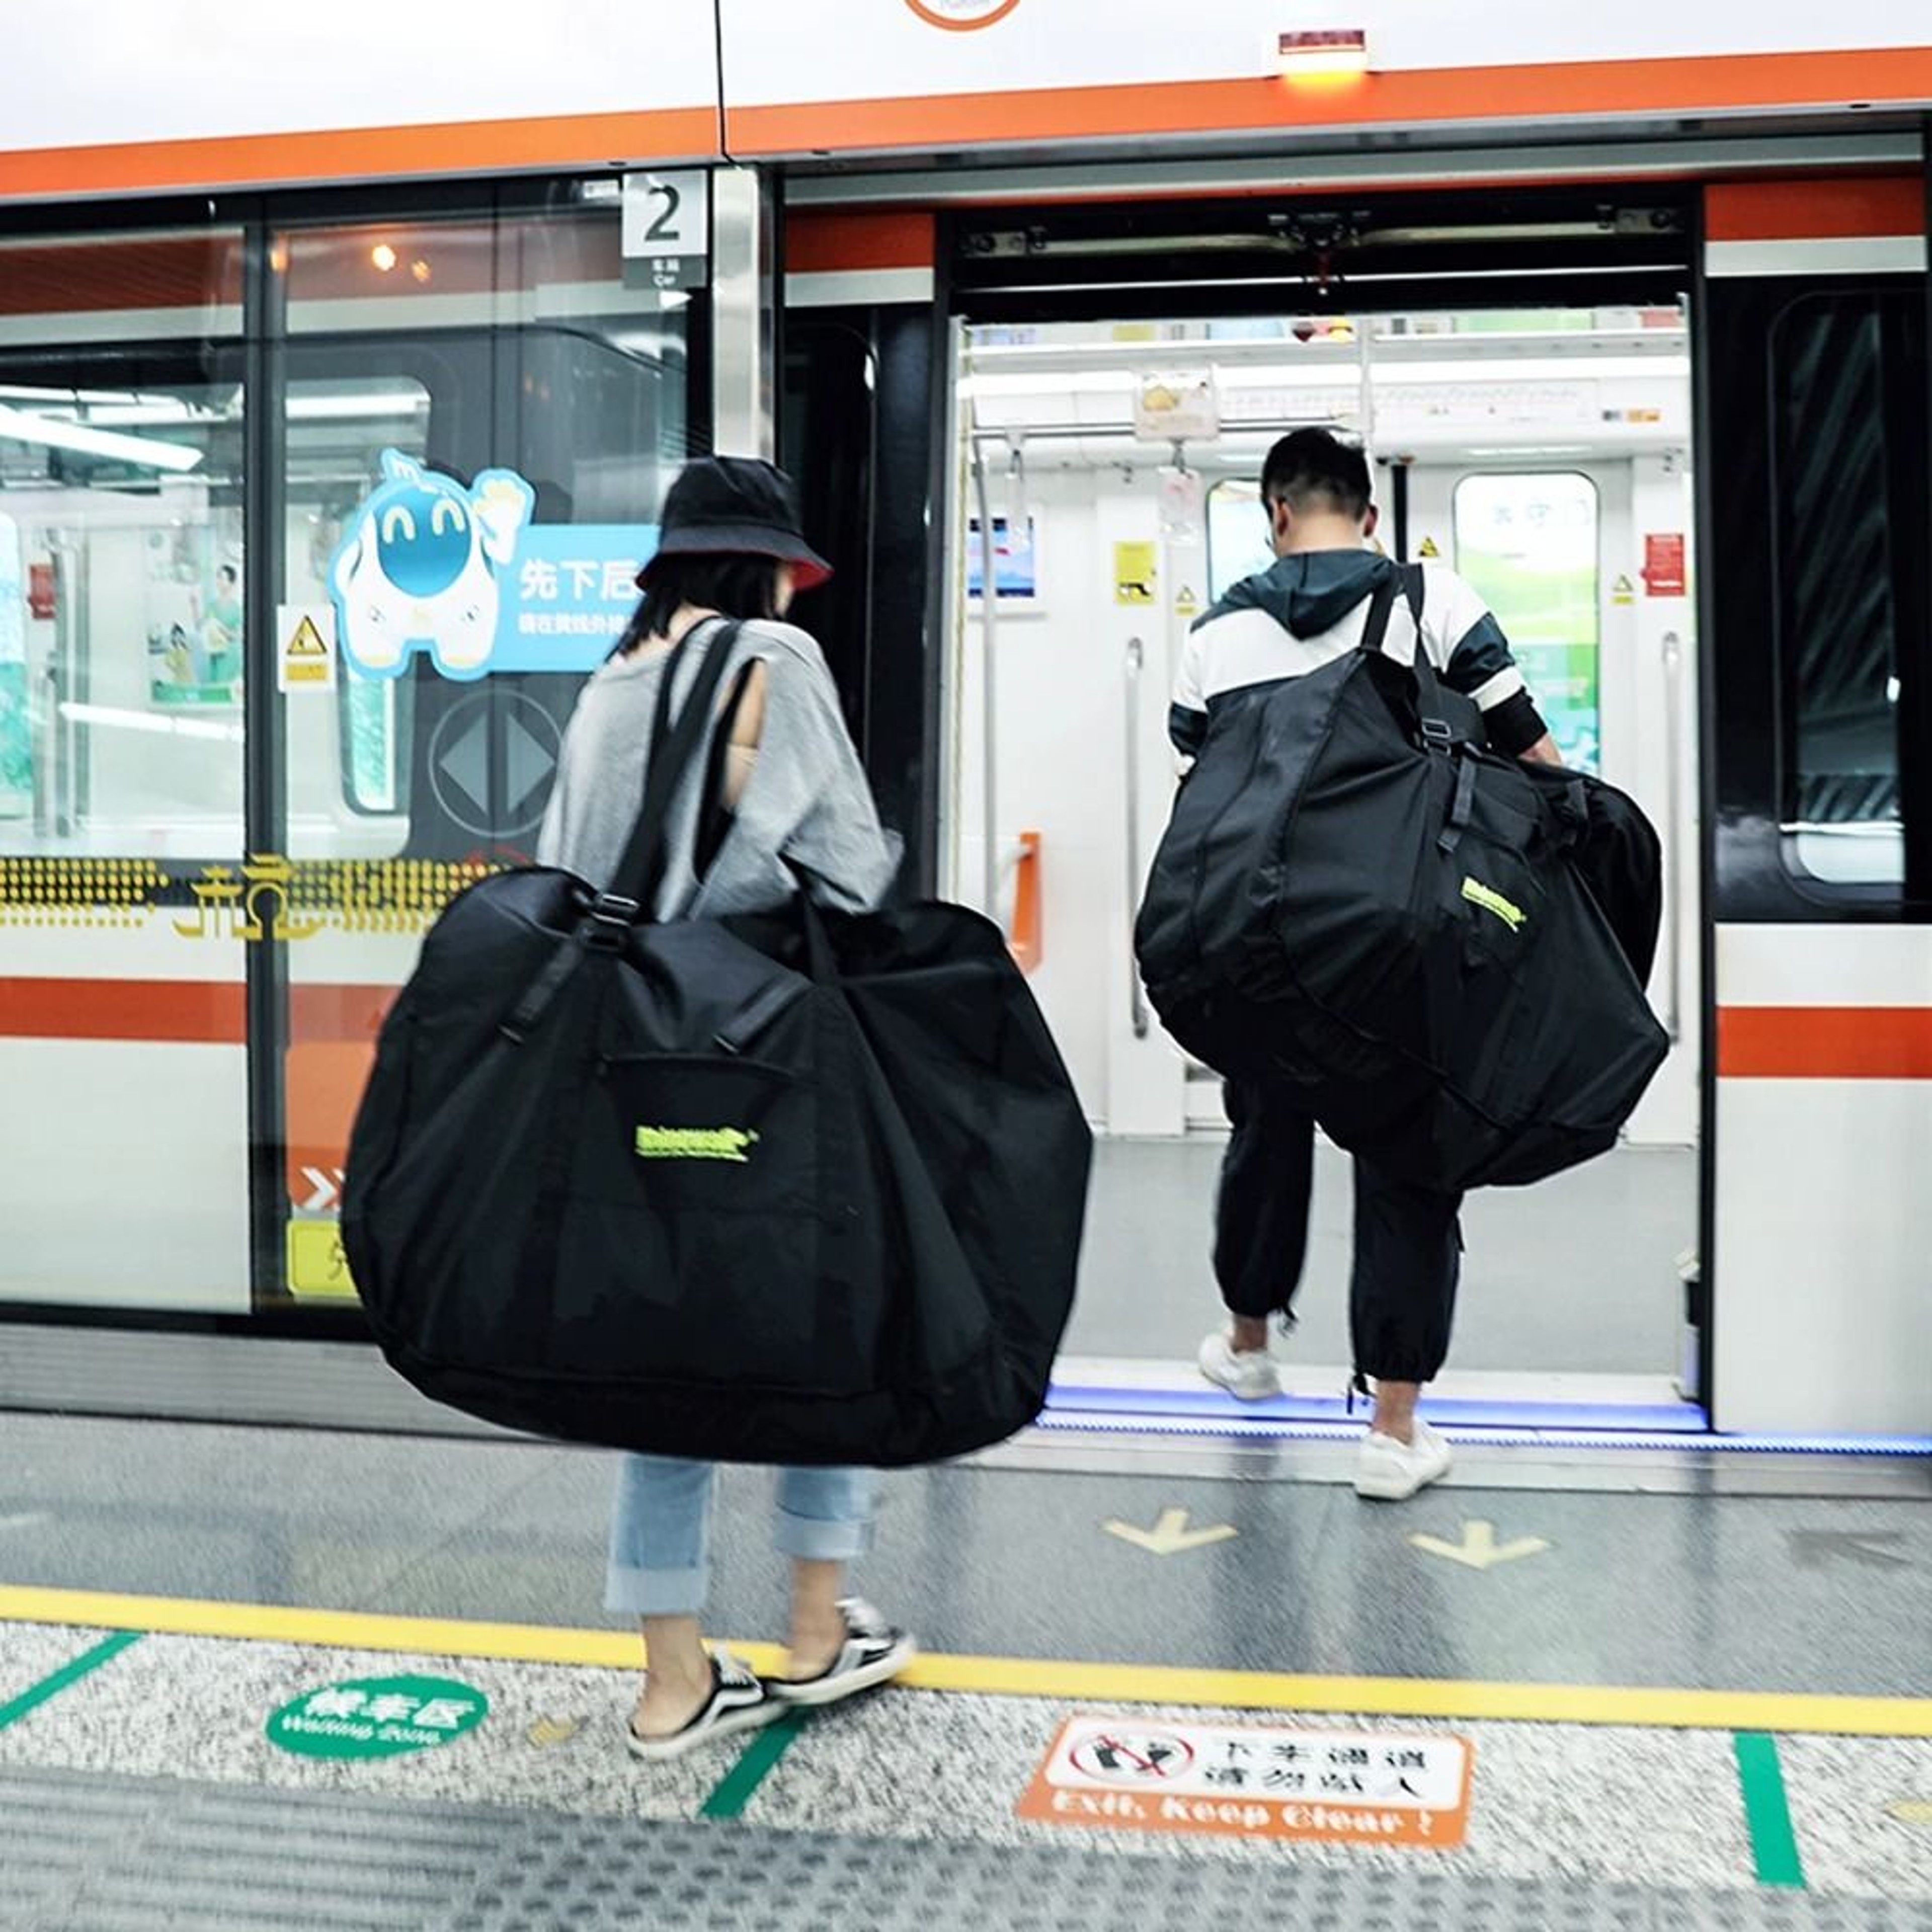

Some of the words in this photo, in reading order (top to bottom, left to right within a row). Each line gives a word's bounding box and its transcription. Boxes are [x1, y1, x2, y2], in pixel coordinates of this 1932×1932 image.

[645, 184, 680, 242] 2
[520, 557, 639, 601] 先下后
[1161, 1795, 1271, 1829] Keep
